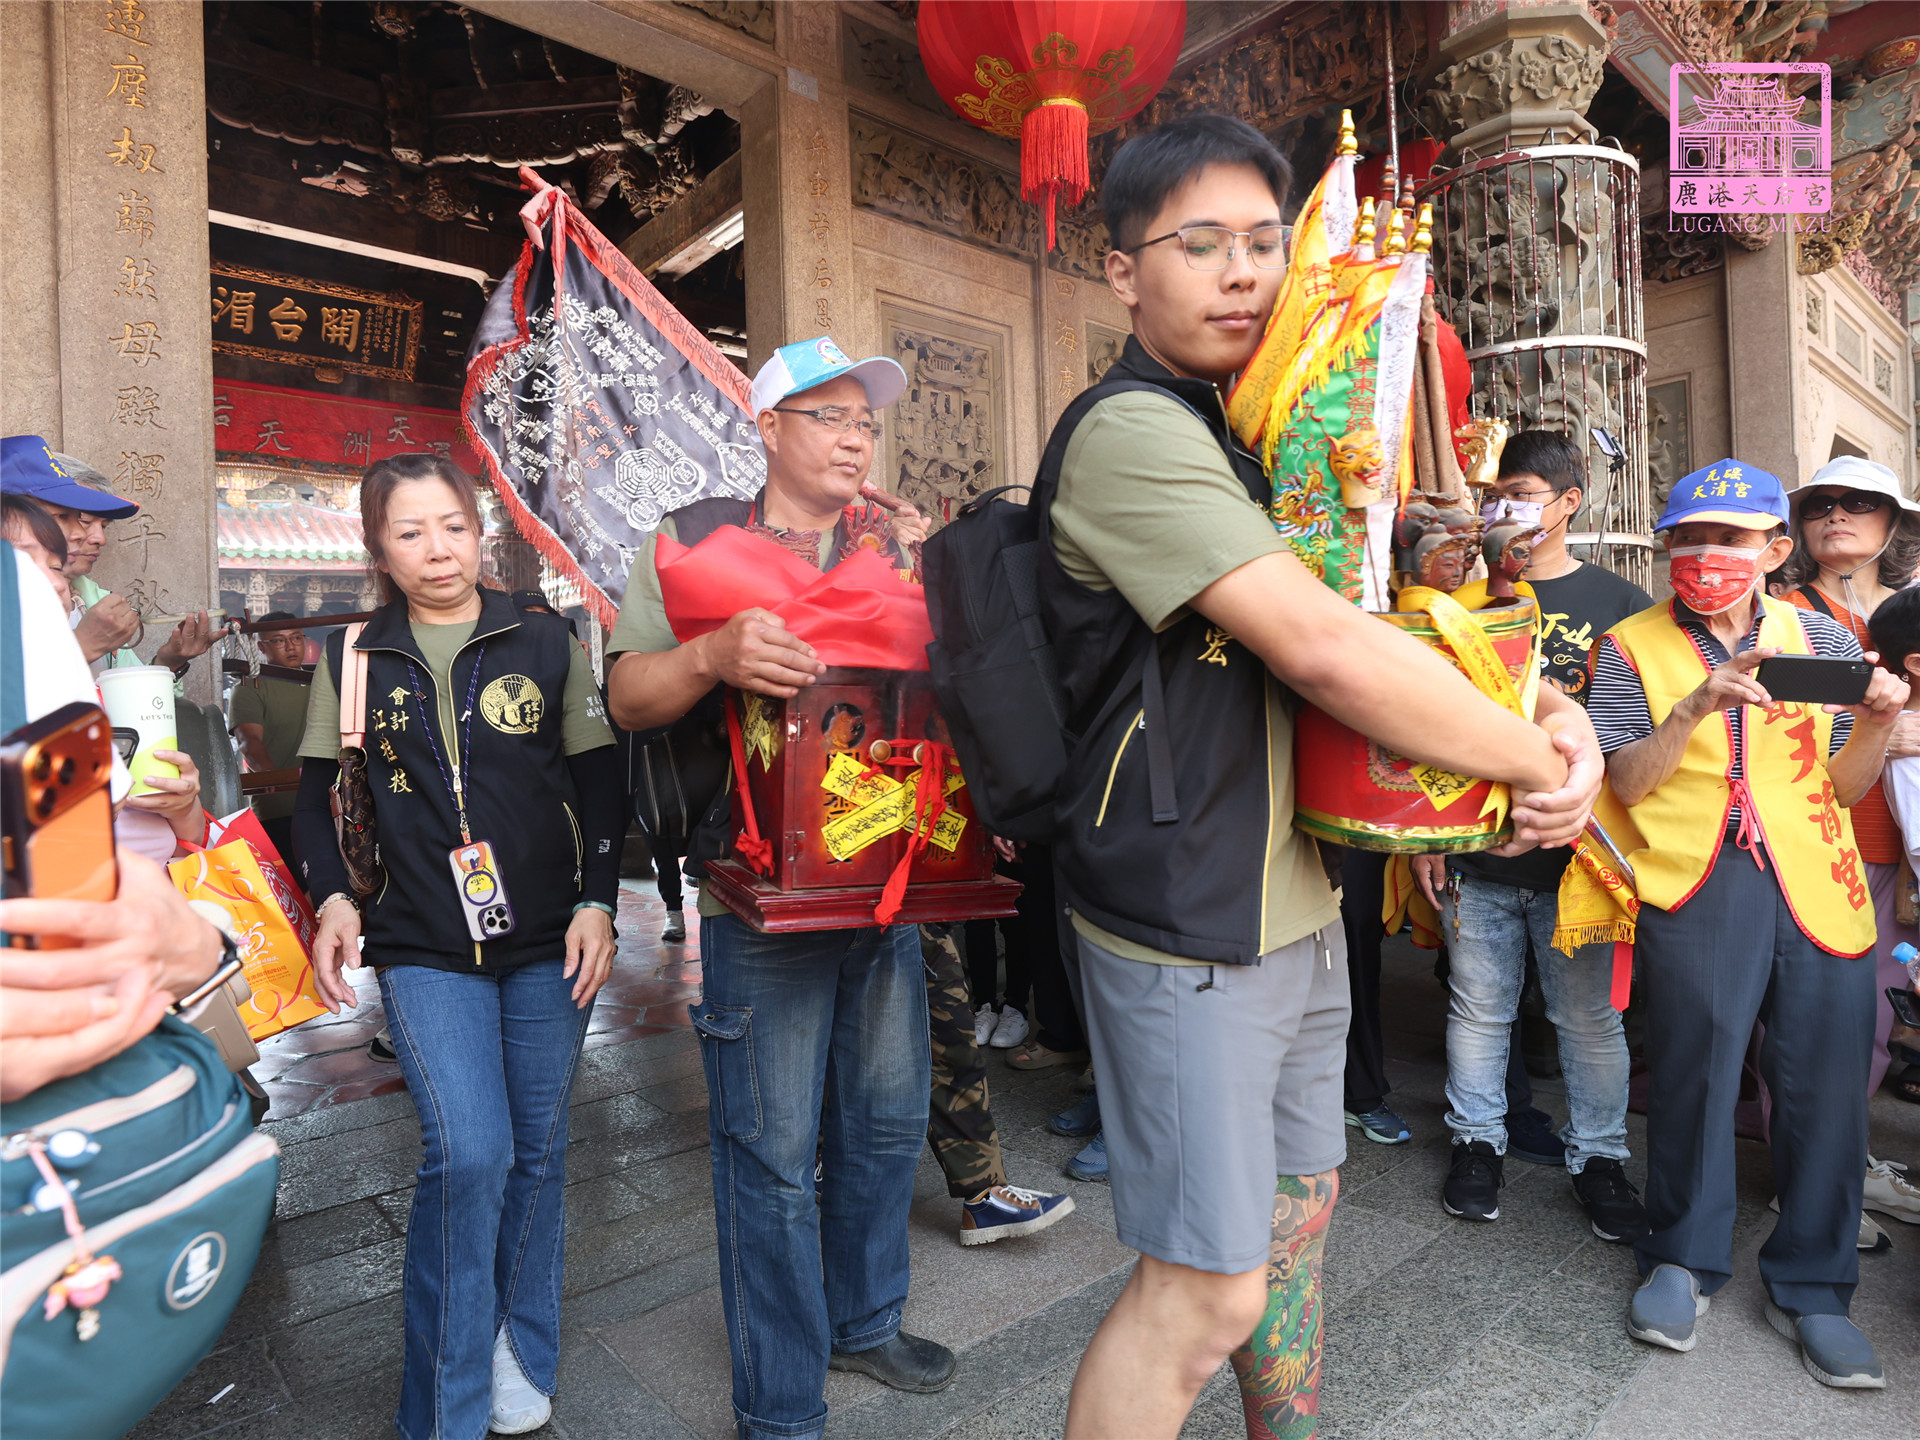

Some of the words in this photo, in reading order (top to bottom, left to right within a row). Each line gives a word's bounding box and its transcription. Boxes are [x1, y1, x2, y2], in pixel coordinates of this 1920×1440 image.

[585, 424, 639, 470] 天上聖母
[1691, 480, 1752, 500] 天清宮
[1532, 612, 1594, 651] 下山
[388, 686, 411, 732] 會計
